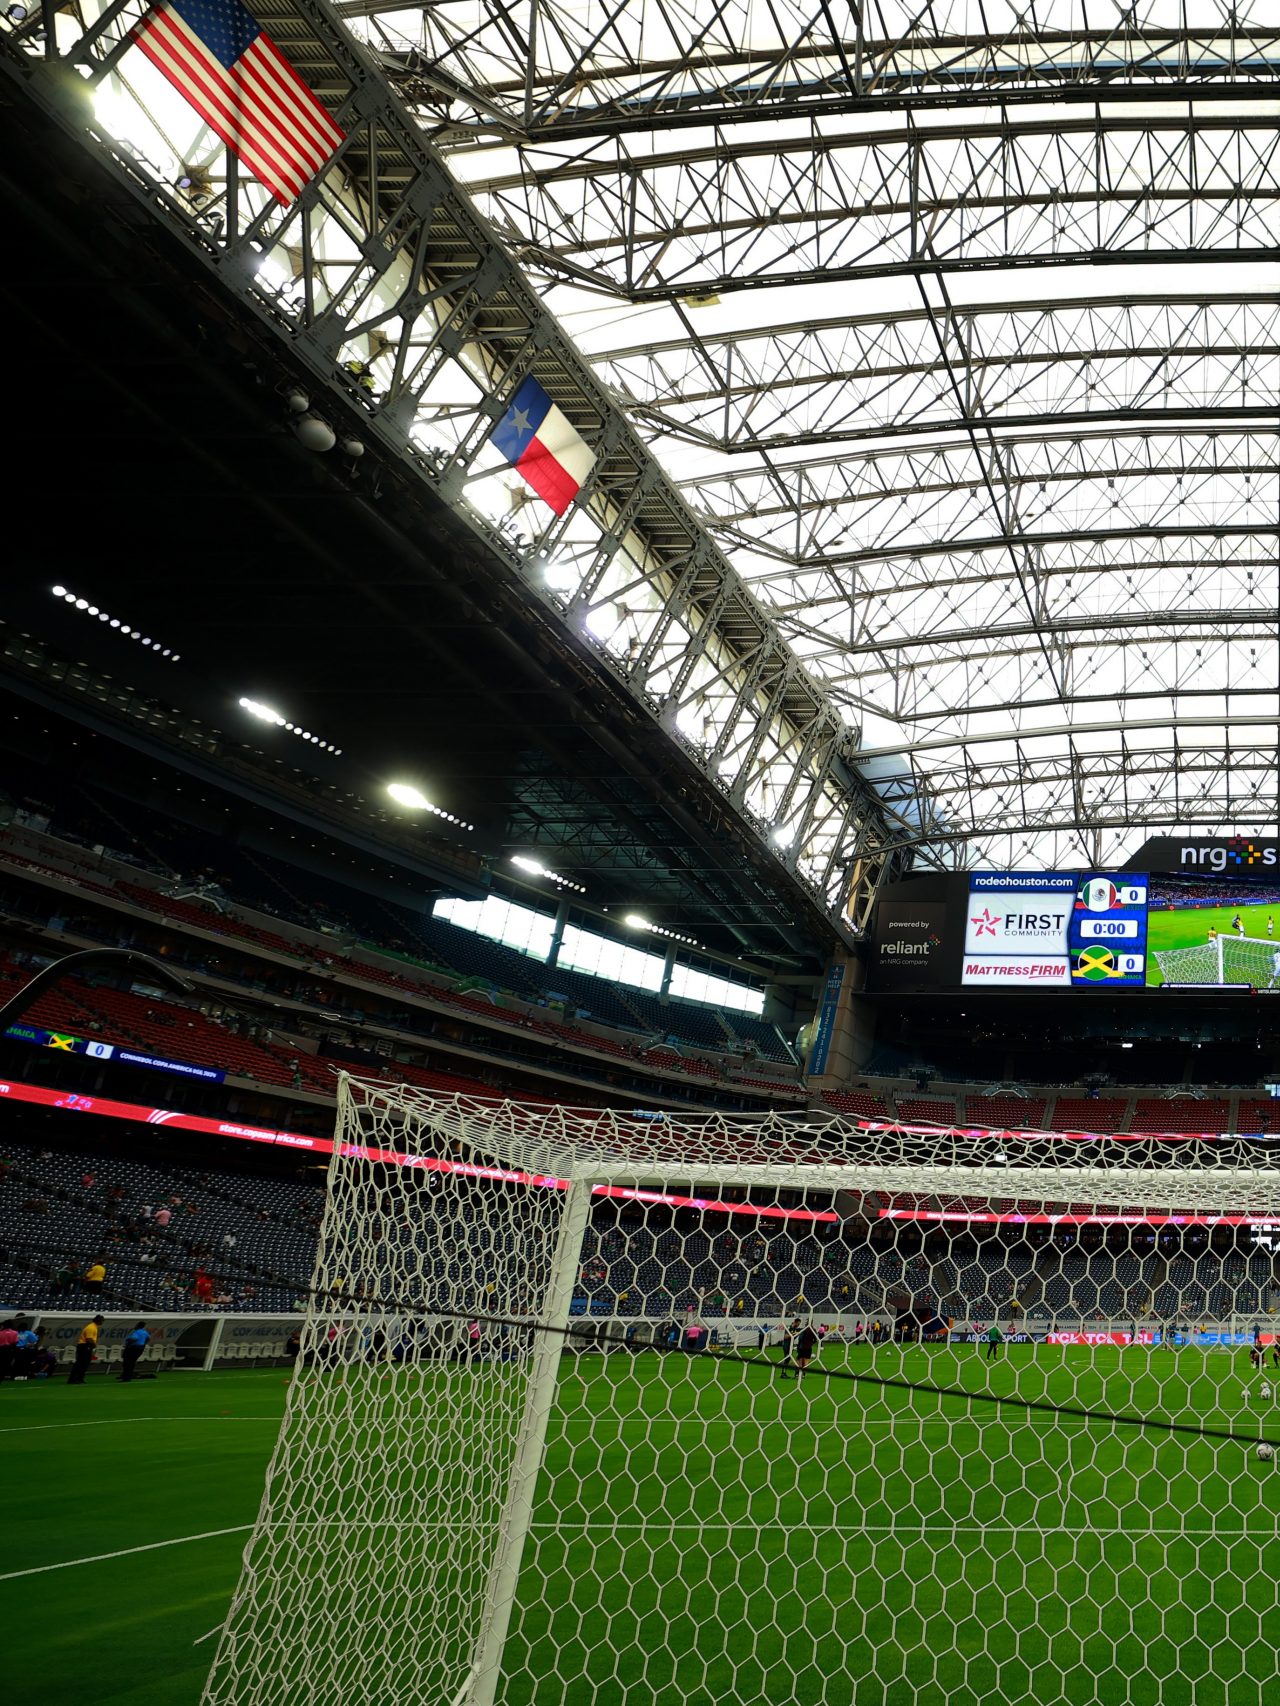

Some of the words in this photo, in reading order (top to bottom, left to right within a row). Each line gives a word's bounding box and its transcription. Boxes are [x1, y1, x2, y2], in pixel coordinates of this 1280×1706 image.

[1181, 846, 1227, 871] nrg
[975, 876, 1073, 887] rodeohouston.com
[1129, 890, 1138, 901] 0
[888, 920, 918, 930] powered
[919, 920, 930, 930] by
[1005, 914, 1065, 929] FIRST
[1093, 923, 1126, 935] 0:00
[880, 940, 930, 955] reliant
[903, 959, 929, 967] company
[1126, 958, 1135, 970] 0
[95, 1044, 104, 1056] 0
[1002, 1334, 1027, 1343] SPORT
[1049, 1333, 1079, 1344] TCL
[1085, 1333, 1116, 1344] TCL
[1122, 1333, 1153, 1344] TCL
